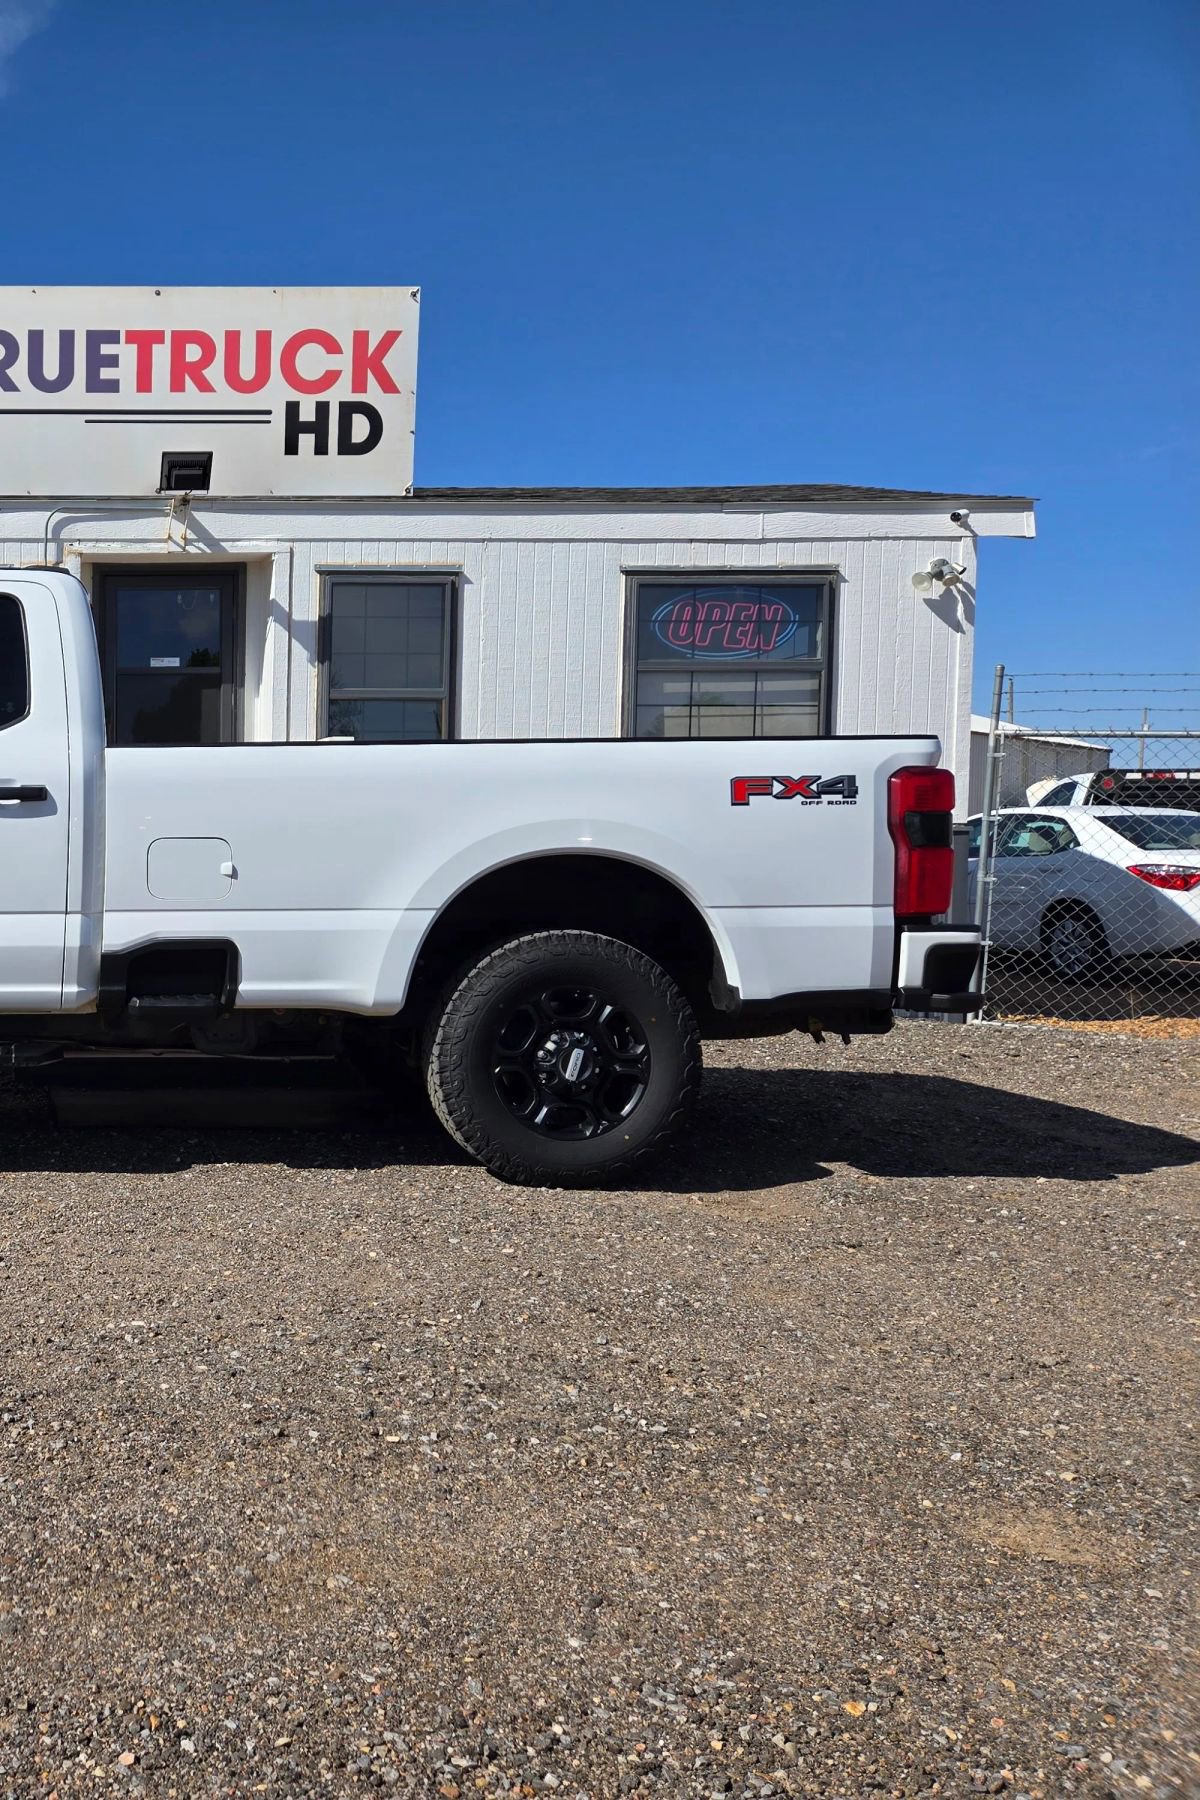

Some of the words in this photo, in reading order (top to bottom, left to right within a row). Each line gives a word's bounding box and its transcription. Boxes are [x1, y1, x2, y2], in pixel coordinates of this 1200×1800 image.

[284, 400, 383, 456] HD
[668, 599, 784, 652] OPEN
[730, 774, 859, 806] FX4
